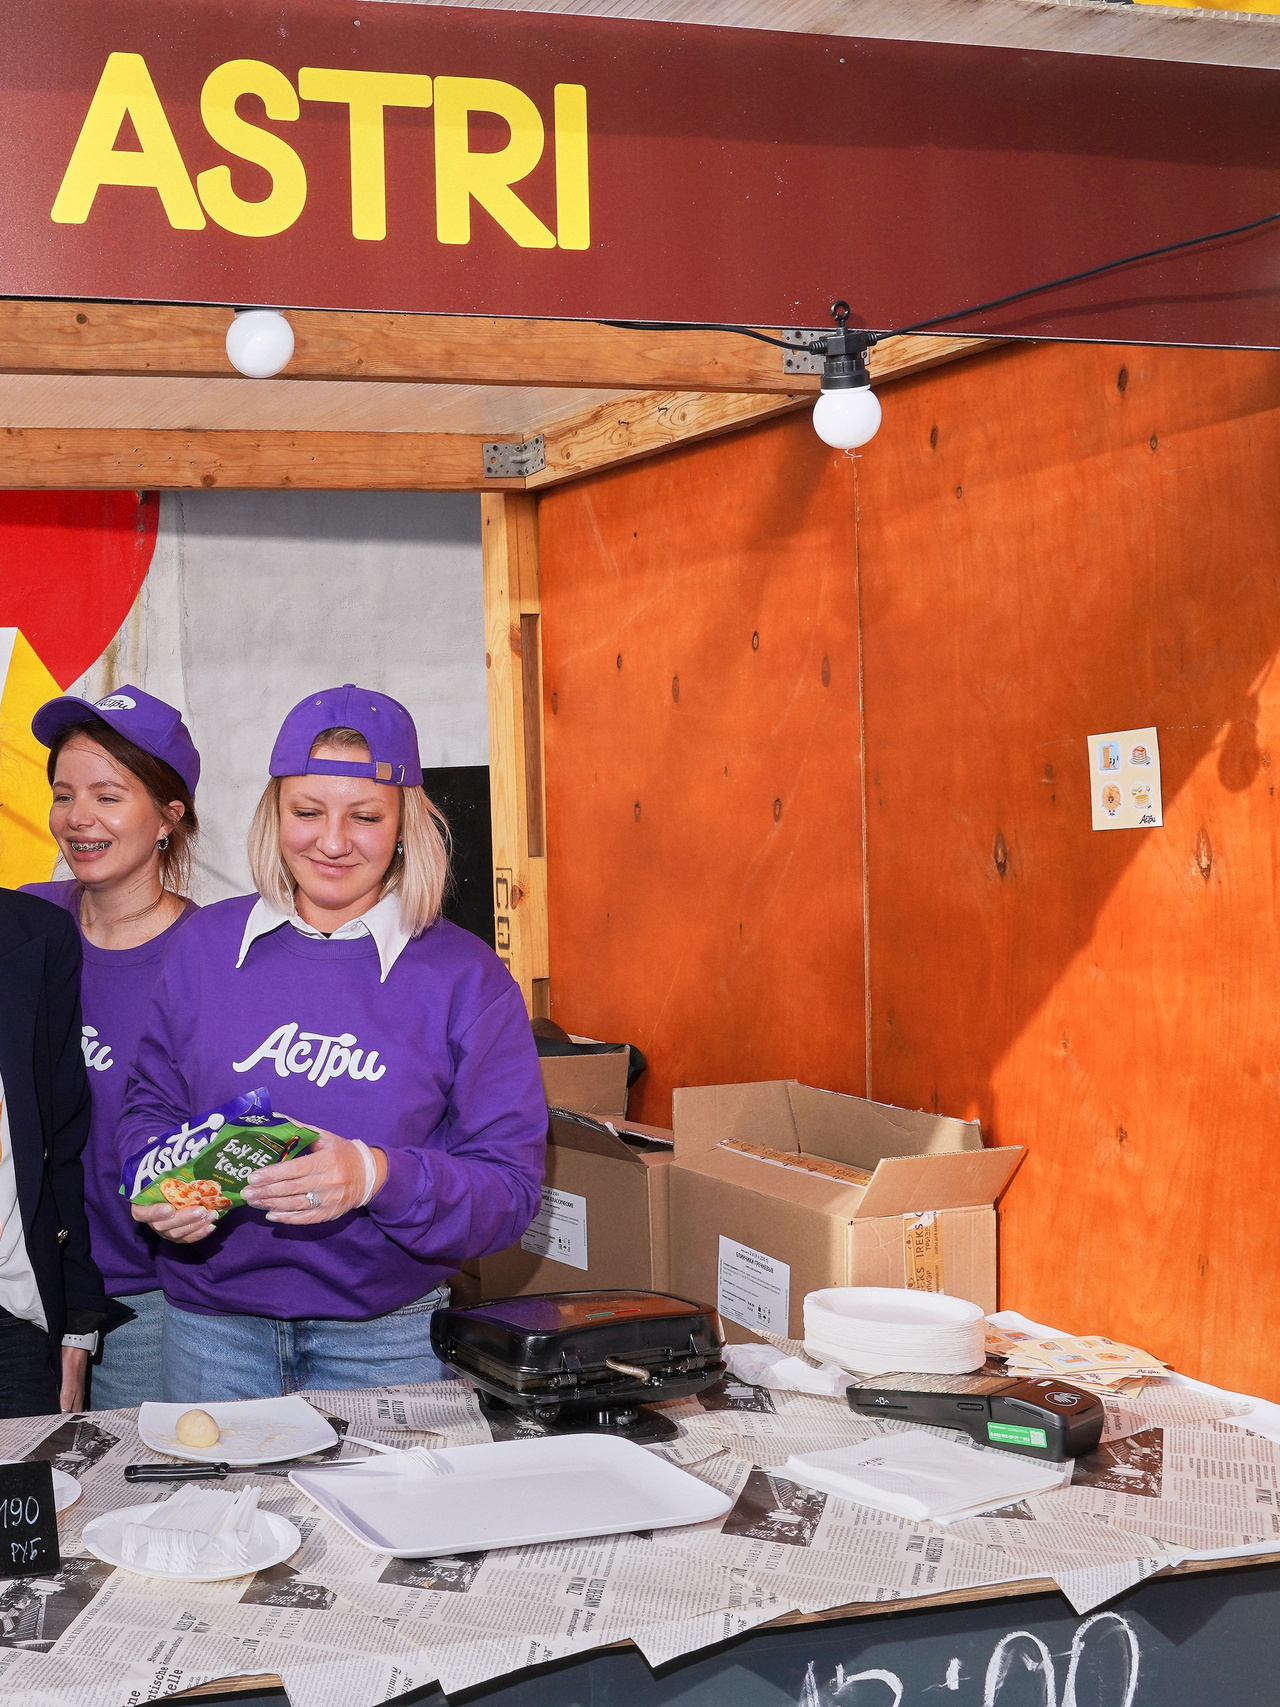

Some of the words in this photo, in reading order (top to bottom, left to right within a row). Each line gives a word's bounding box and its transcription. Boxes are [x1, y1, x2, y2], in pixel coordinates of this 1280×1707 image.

[50, 52, 591, 251] ASTRI
[232, 1022, 387, 1088] Астри
[914, 1223, 924, 1258] IREKS
